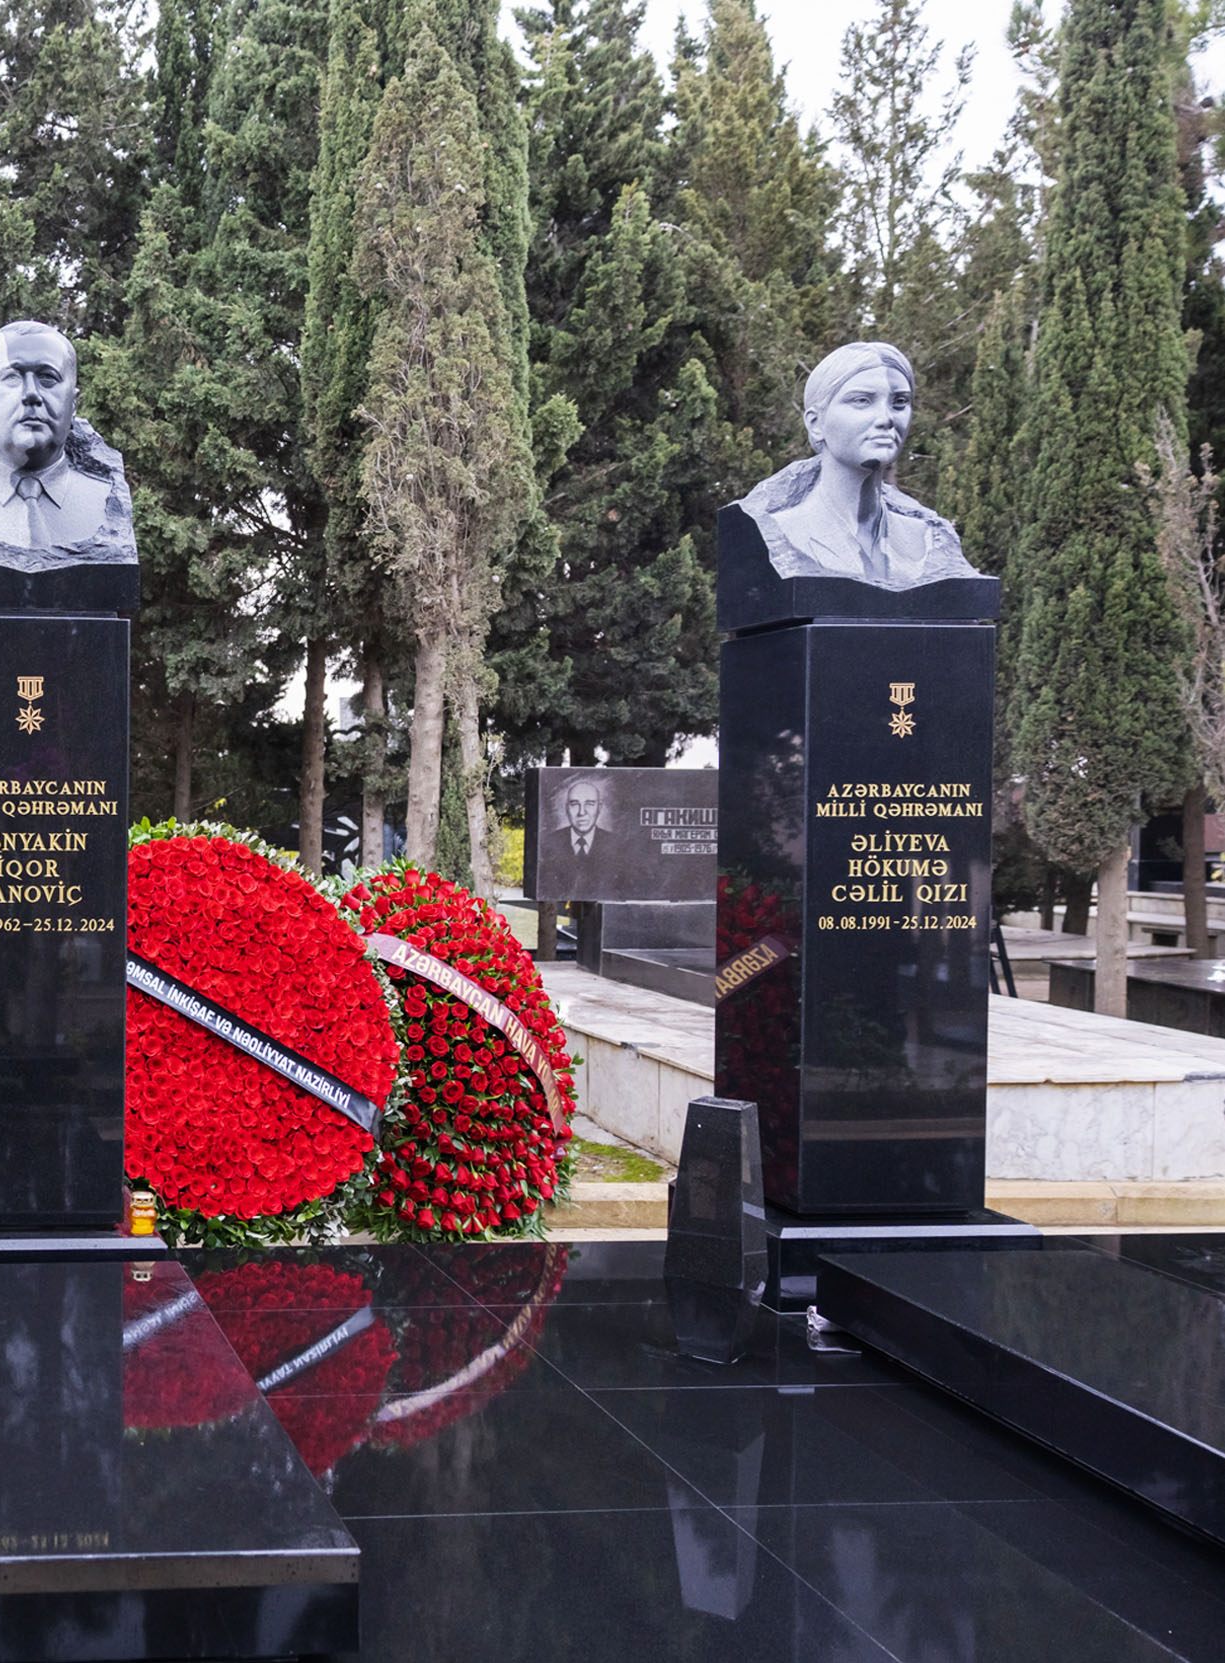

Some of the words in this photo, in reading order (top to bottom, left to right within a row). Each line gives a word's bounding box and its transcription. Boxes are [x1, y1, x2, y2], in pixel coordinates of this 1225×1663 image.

[827, 783, 972, 798] AZƏRBAYCANIN
[2, 801, 118, 817] QƏHRƏMANI
[816, 800, 866, 817] MİLLİ
[874, 803, 984, 819] QƏHRƏMANI
[851, 830, 951, 852] ƏLİYEVA
[848, 855, 948, 878] HÖKUMƏ
[831, 881, 903, 903] CƏLİL
[915, 884, 968, 905] QIZI
[391, 944, 505, 1025] AZƏRBAYCAN
[505, 1015, 536, 1064] HAVA
[167, 984, 216, 1023] İNKİŞAF
[215, 1015, 232, 1034] VƏ
[232, 1028, 296, 1075] NƏQLİYYAT
[294, 1065, 353, 1109] NAZİRLİYİ
